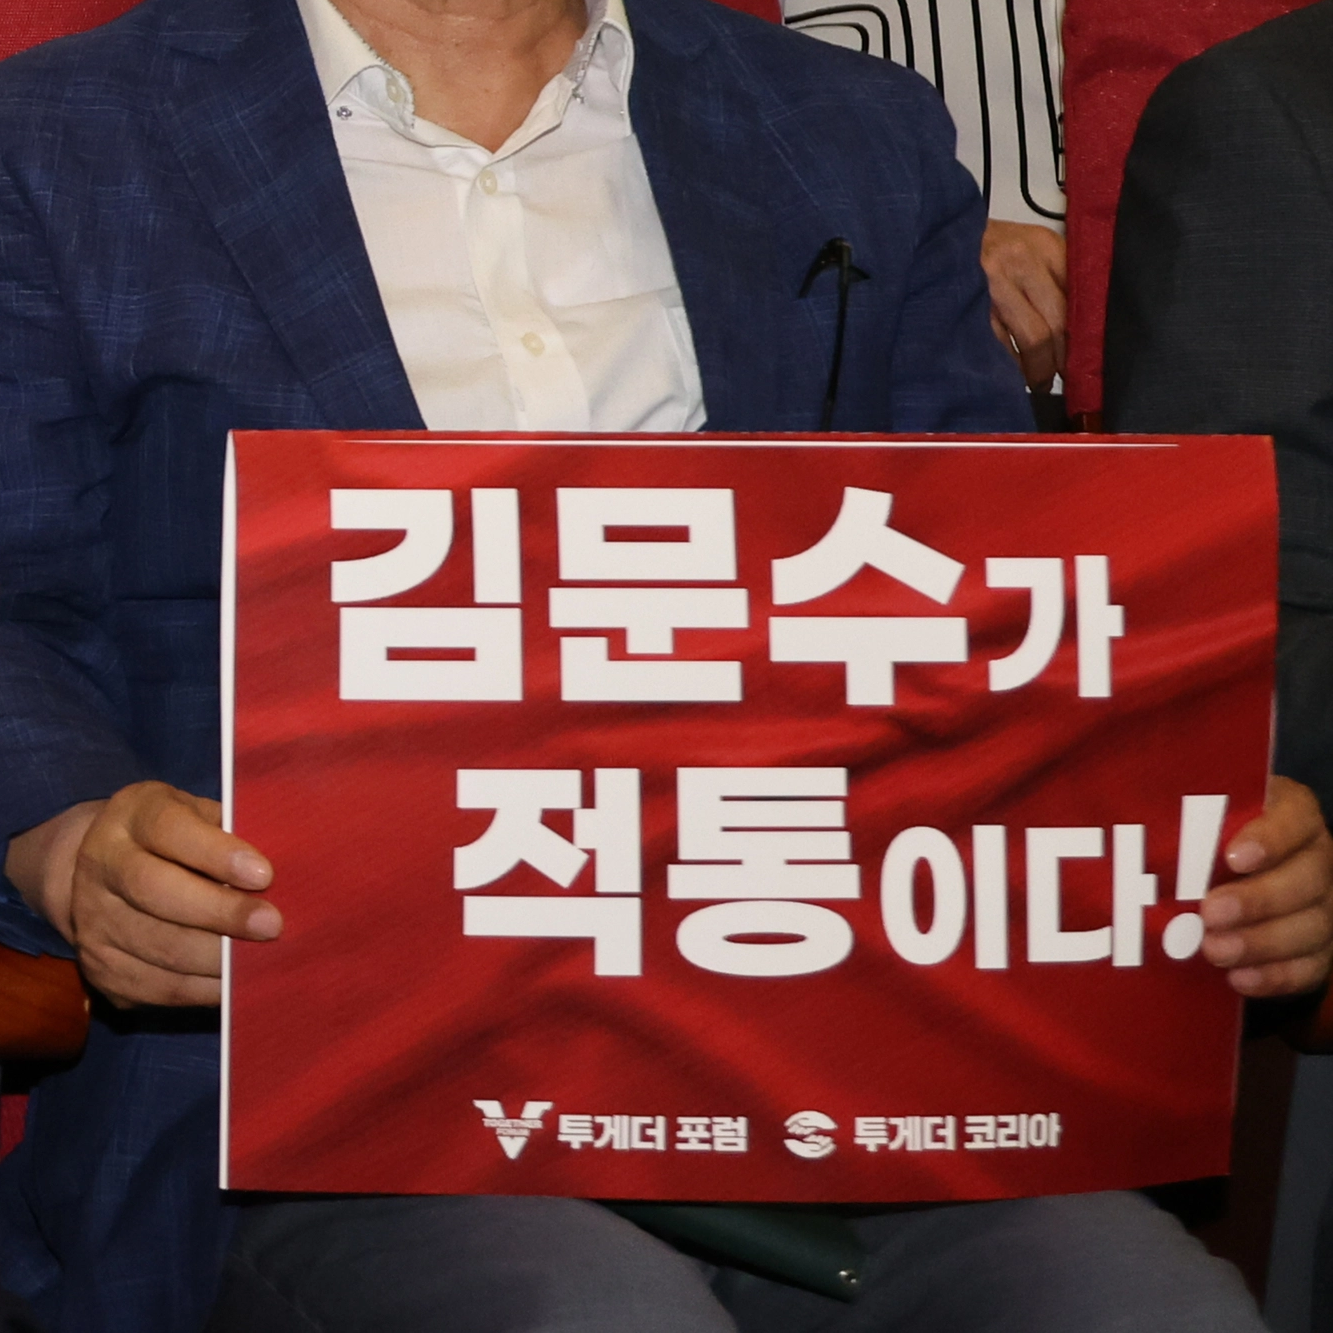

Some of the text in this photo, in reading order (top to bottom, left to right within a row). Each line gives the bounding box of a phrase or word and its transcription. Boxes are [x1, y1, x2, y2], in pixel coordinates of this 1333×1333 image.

[330, 486, 1124, 706] 김문수가
[453, 766, 1230, 978] 적통이다!
[557, 1114, 748, 1152] 투게더 포럼
[854, 1112, 1061, 1152] 투게더 코리아
